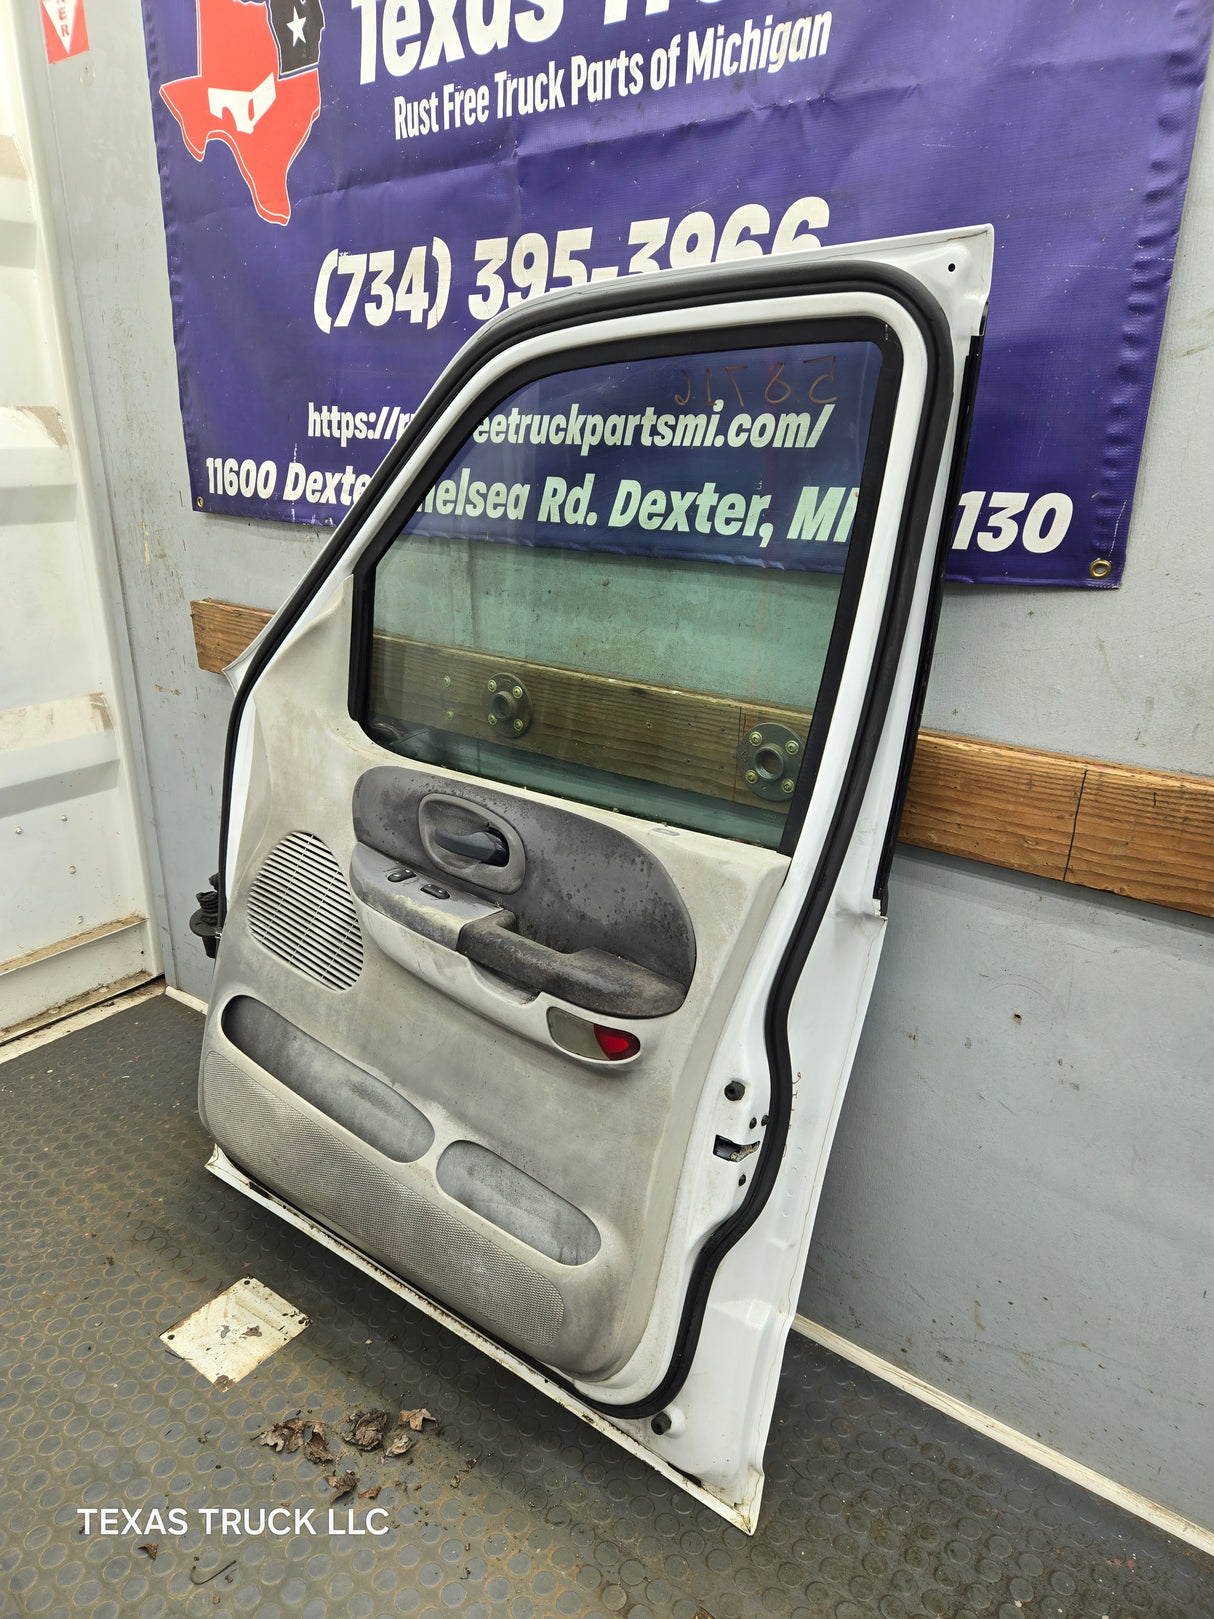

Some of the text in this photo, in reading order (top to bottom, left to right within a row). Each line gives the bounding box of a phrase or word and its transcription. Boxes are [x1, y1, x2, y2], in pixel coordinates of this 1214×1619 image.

[394, 96, 439, 140] Rust
[442, 84, 489, 130] Free
[494, 70, 565, 119] Truck
[571, 51, 644, 104] Parts
[650, 34, 681, 88] of
[687, 10, 833, 82] Michigan
[313, 236, 452, 334] (734)
[205, 458, 277, 499] 11600
[537, 473, 597, 526] Rd.
[608, 479, 773, 548] Dexter,
[786, 486, 860, 543] MI
[951, 490, 1074, 554] 130
